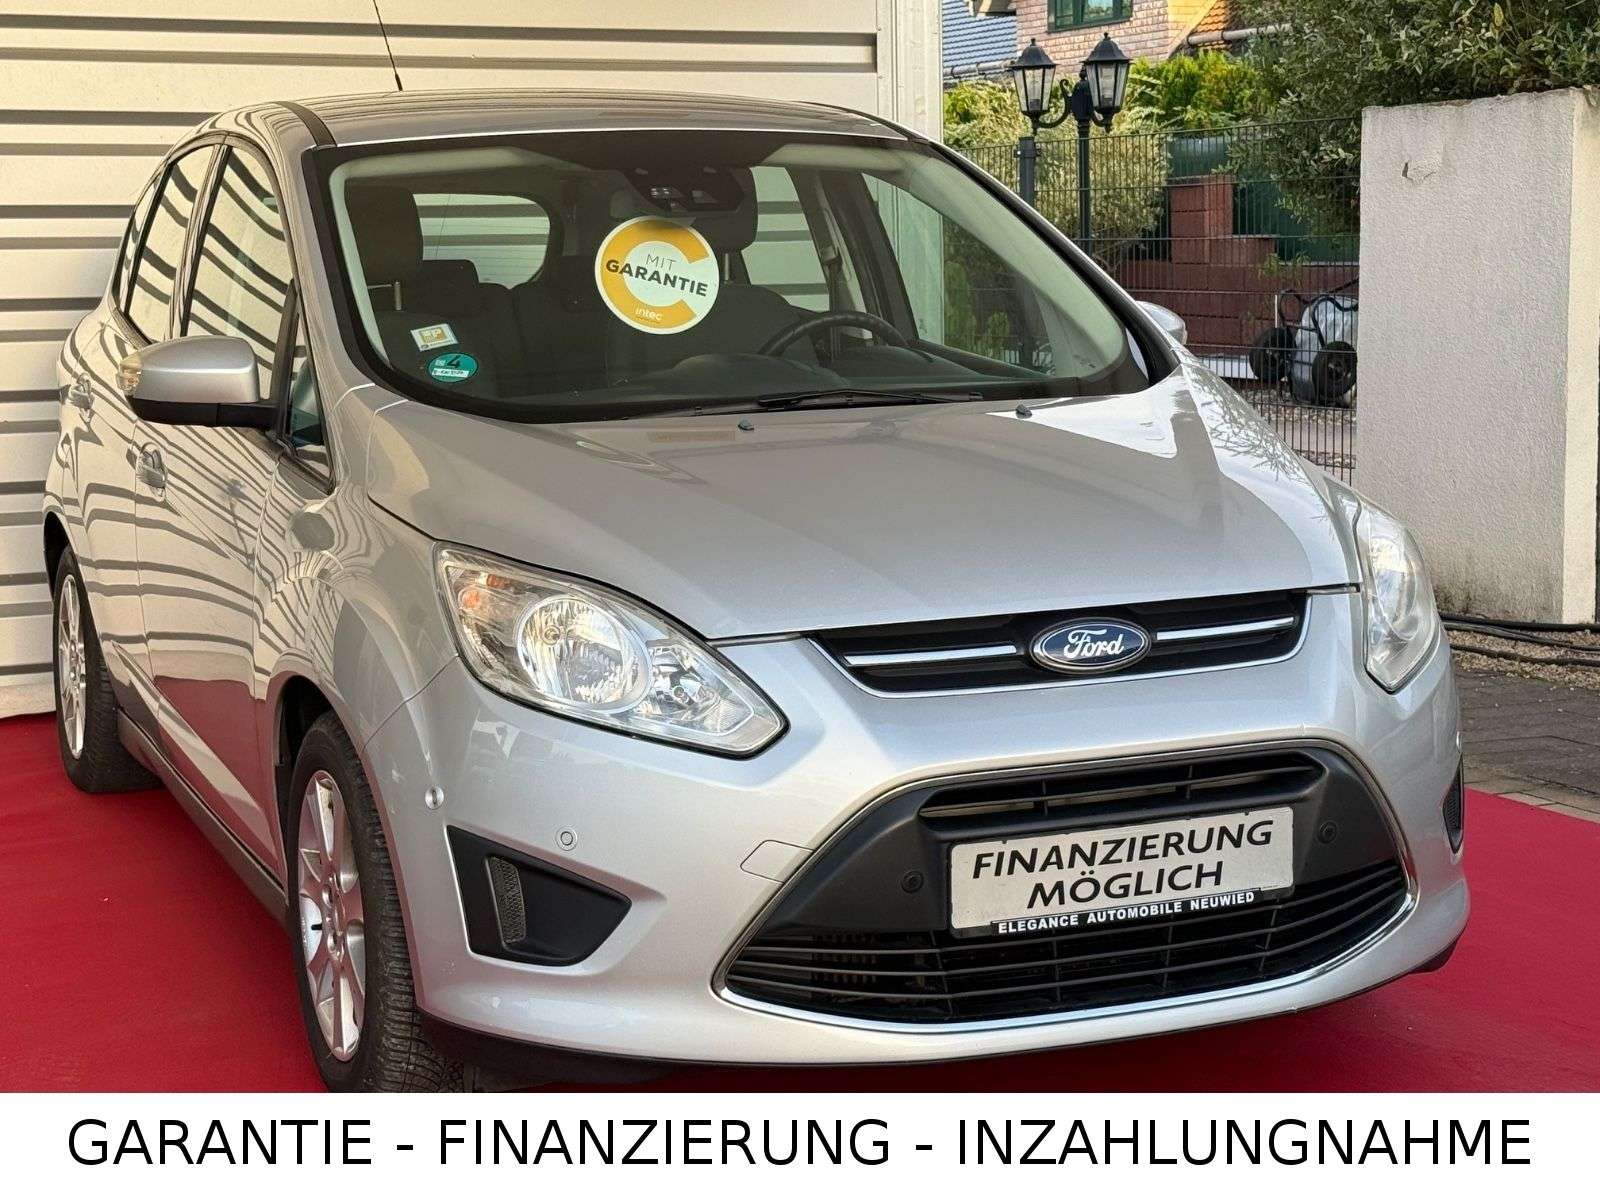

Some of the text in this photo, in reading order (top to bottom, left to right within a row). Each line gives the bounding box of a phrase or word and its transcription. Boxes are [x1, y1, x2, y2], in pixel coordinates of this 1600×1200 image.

[605, 259, 709, 298] GARANTIE
[645, 254, 677, 271] MIT
[635, 307, 664, 322] intec
[446, 355, 462, 370] 4
[1063, 628, 1125, 659] Ford
[972, 819, 1274, 879] FINANZIERUNG
[1026, 860, 1224, 909] MÖGLICH
[997, 891, 1255, 934] ELEGANCE AUTOMOBILE NEUWIED
